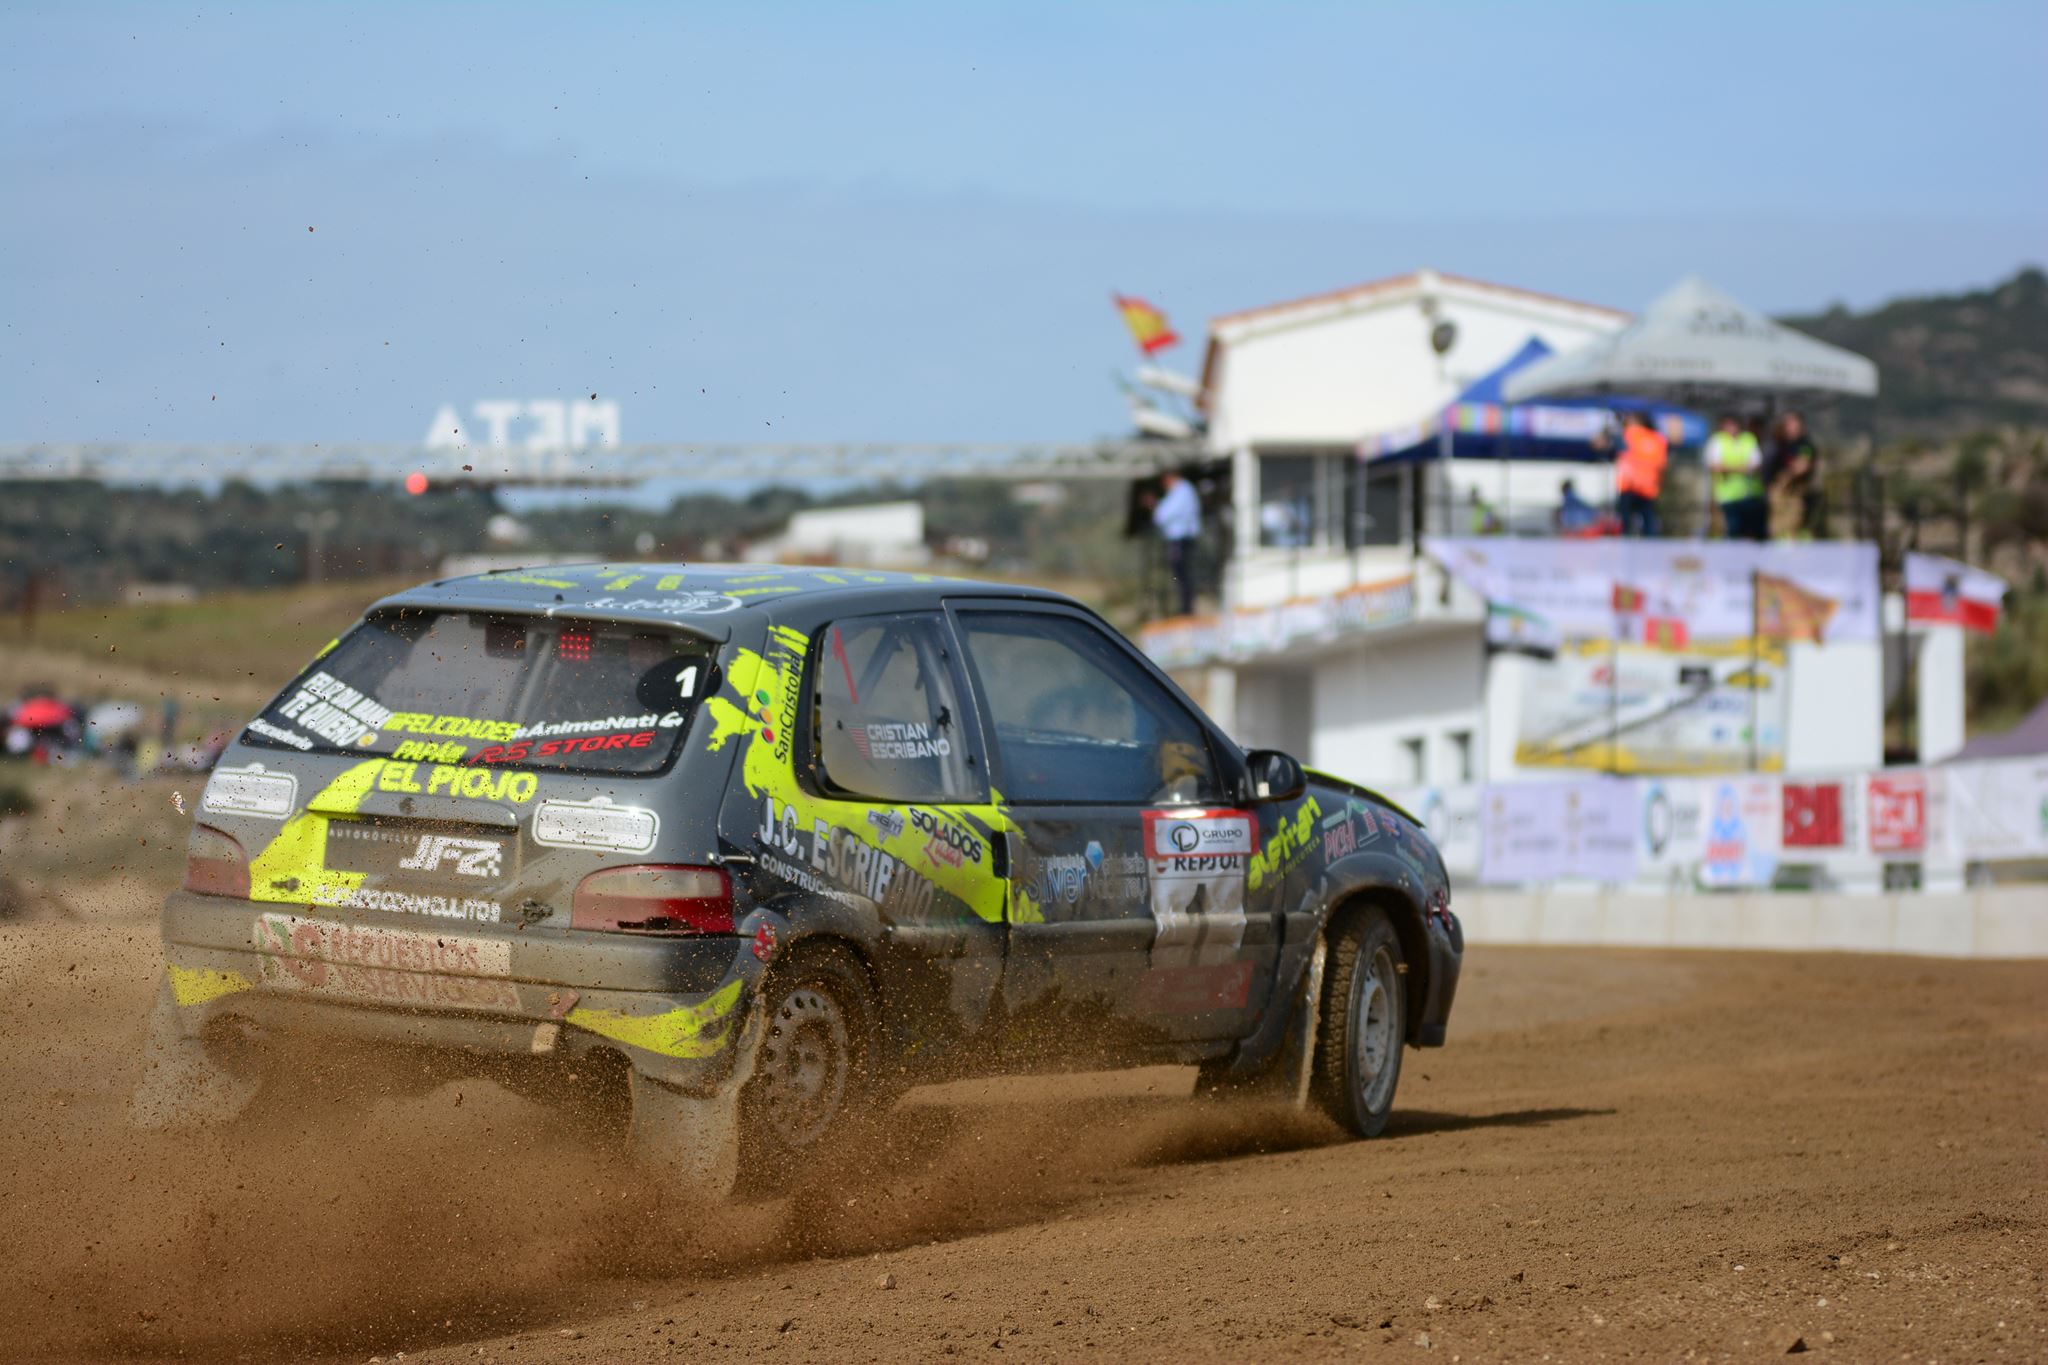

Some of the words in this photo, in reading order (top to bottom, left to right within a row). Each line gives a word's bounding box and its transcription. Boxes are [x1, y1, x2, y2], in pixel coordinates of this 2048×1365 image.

[676, 666, 697, 697] 1
[867, 723, 929, 740] CRISTIAN
[536, 732, 657, 757] STORE
[871, 738, 951, 759] ESCRIBANO
[378, 761, 421, 793] EL
[427, 764, 539, 803] PIOJO
[909, 808, 982, 864] SOLADOS
[1202, 829, 1243, 838] GRUPO
